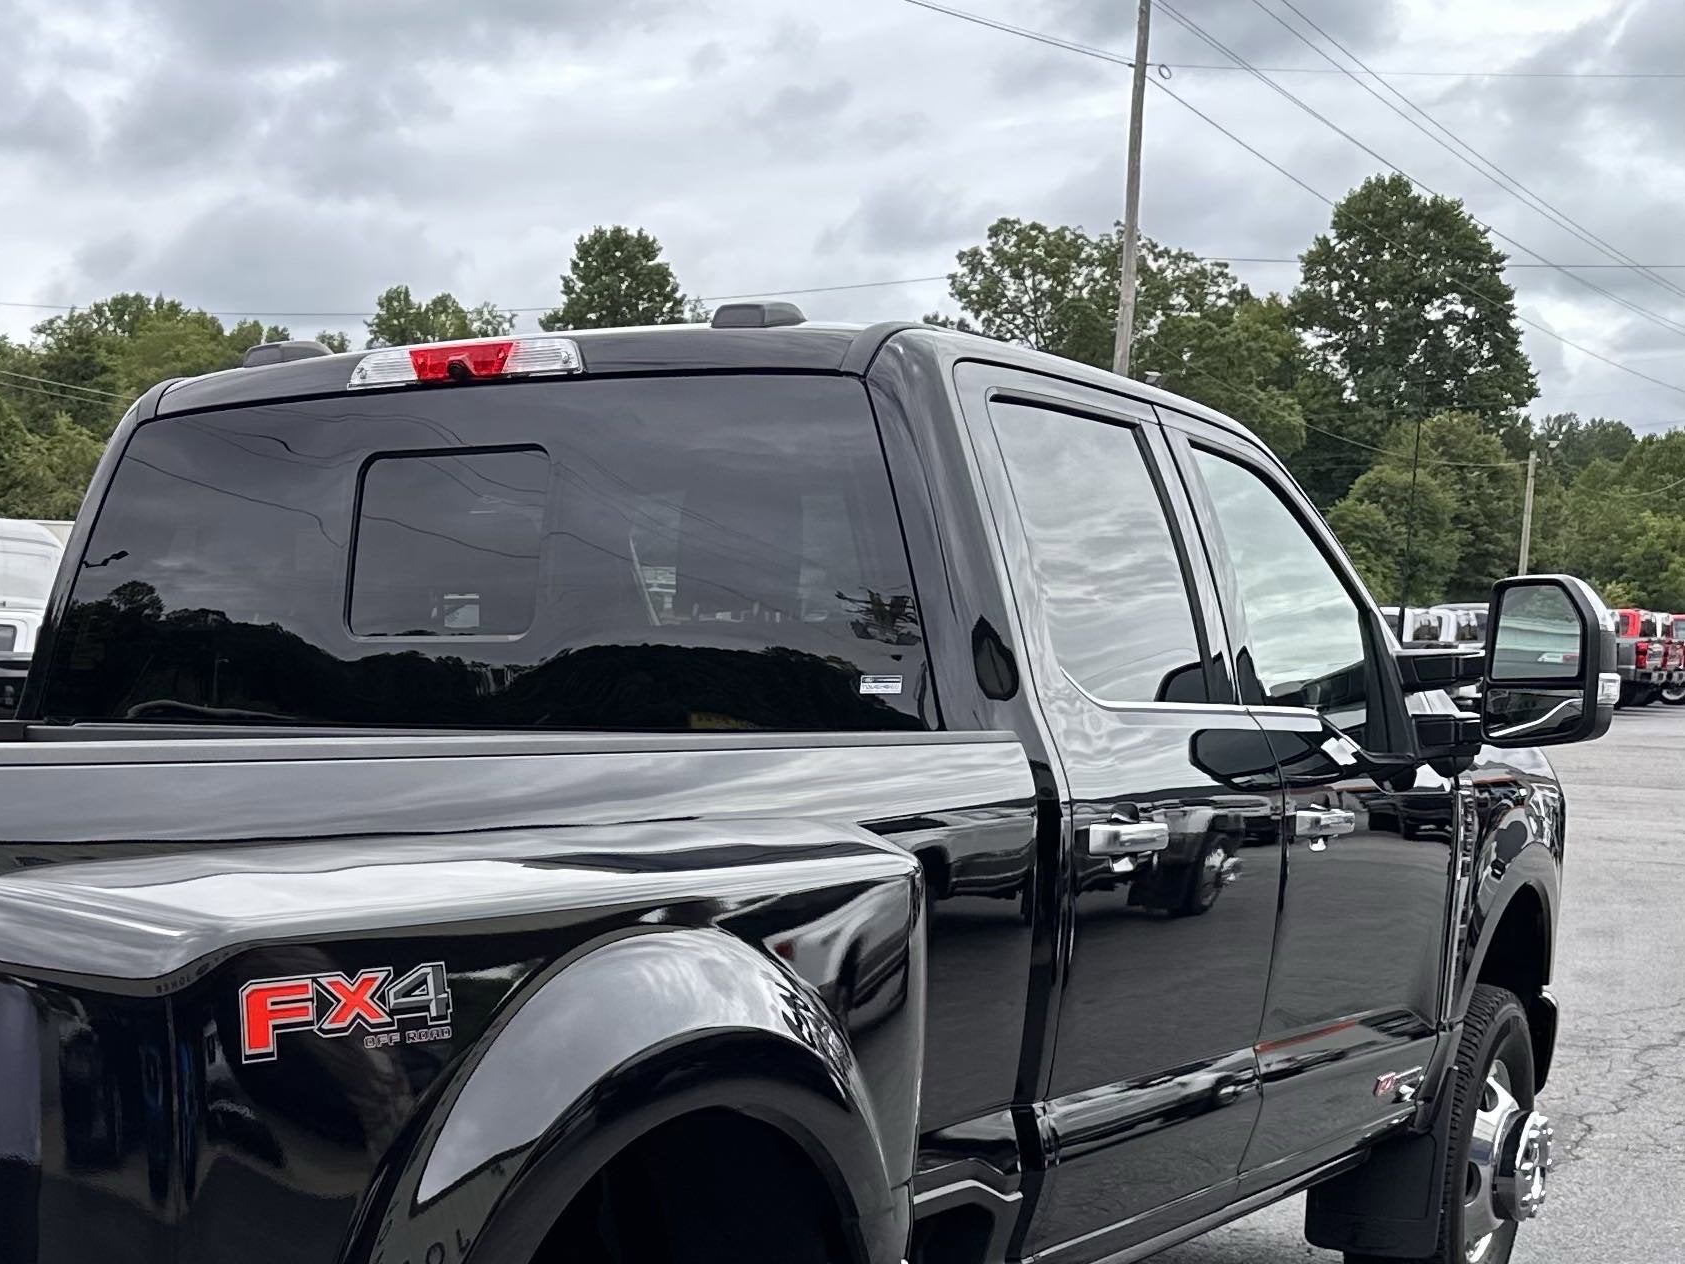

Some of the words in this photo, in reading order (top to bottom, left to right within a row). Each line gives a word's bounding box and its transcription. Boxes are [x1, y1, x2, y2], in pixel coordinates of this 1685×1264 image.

[239, 961, 453, 1064] FX4
[364, 1032, 402, 1048] OFF
[405, 1026, 453, 1043] ROAD
